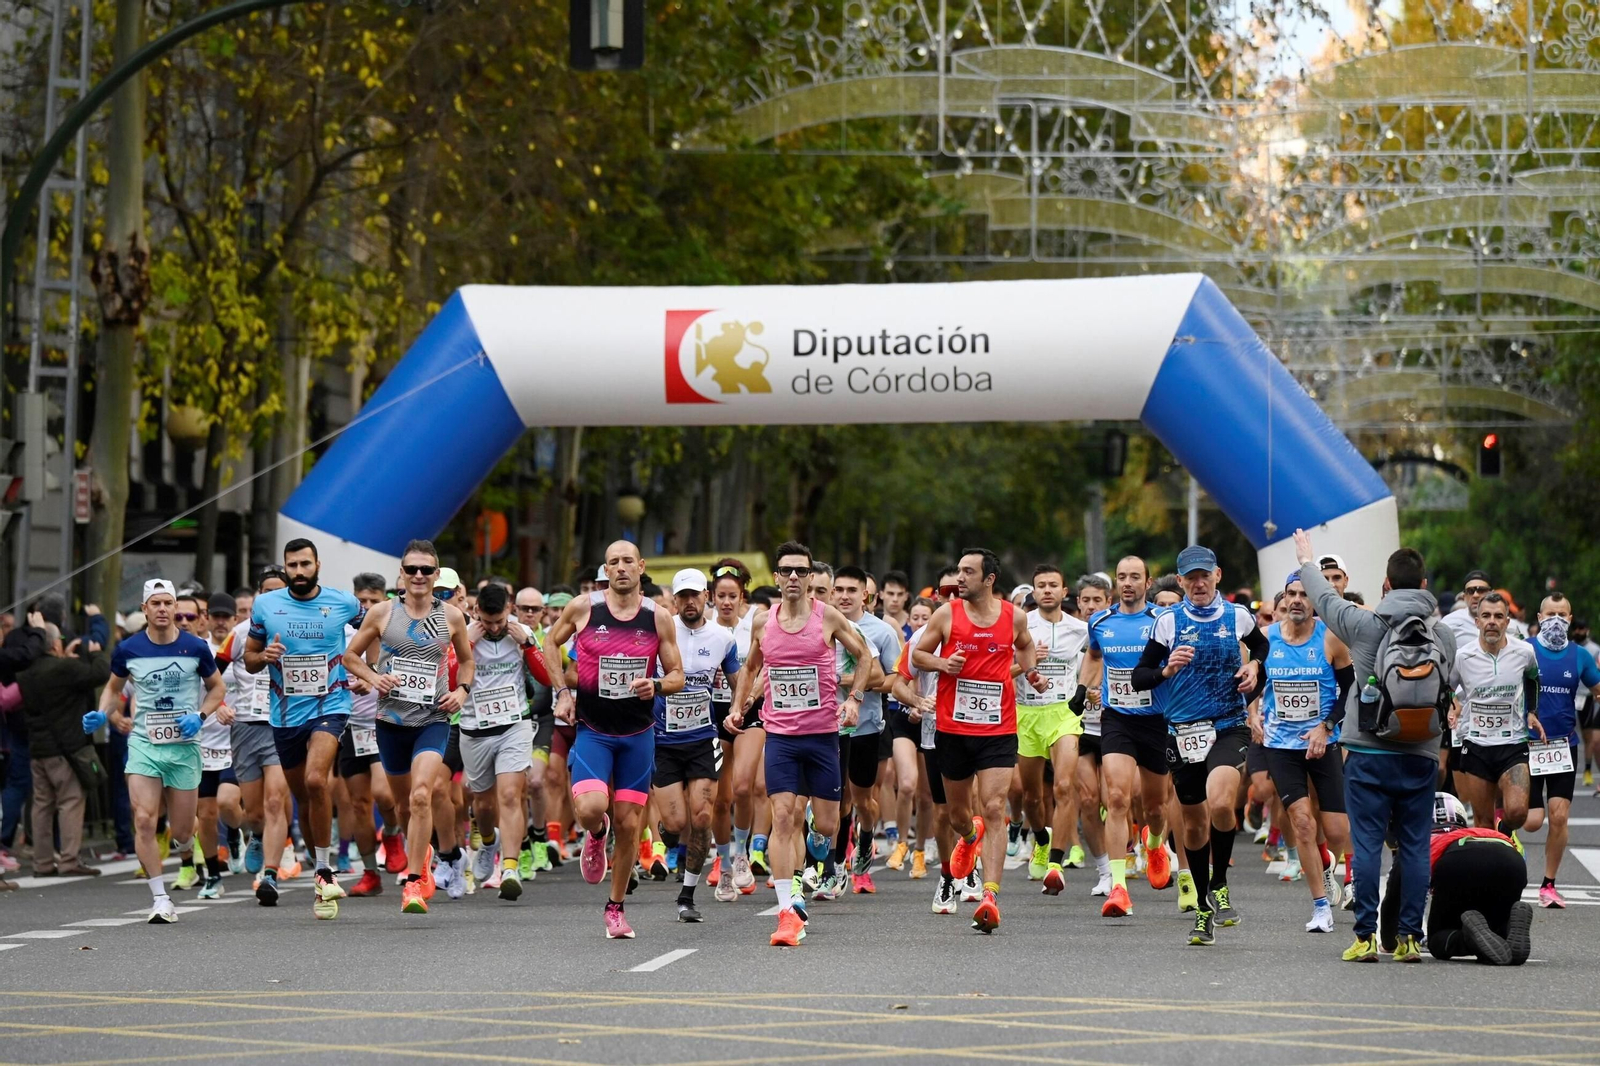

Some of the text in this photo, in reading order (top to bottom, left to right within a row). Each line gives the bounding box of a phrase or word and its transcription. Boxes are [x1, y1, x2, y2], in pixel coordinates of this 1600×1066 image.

[793, 327, 990, 363] Diputación
[791, 366, 993, 395] de Córdoba
[292, 670, 319, 683] 518
[1268, 667, 1323, 676] TROTASIERRA
[400, 674, 427, 690] 388
[609, 672, 635, 685] 511
[780, 683, 808, 696] 316
[485, 700, 510, 715] 131
[969, 696, 987, 711] 36
[1283, 695, 1309, 708] 669
[676, 705, 701, 719] 676
[1478, 716, 1503, 728] 553
[155, 726, 181, 739] 605
[1184, 735, 1207, 752] 635
[1537, 751, 1562, 763] 610
